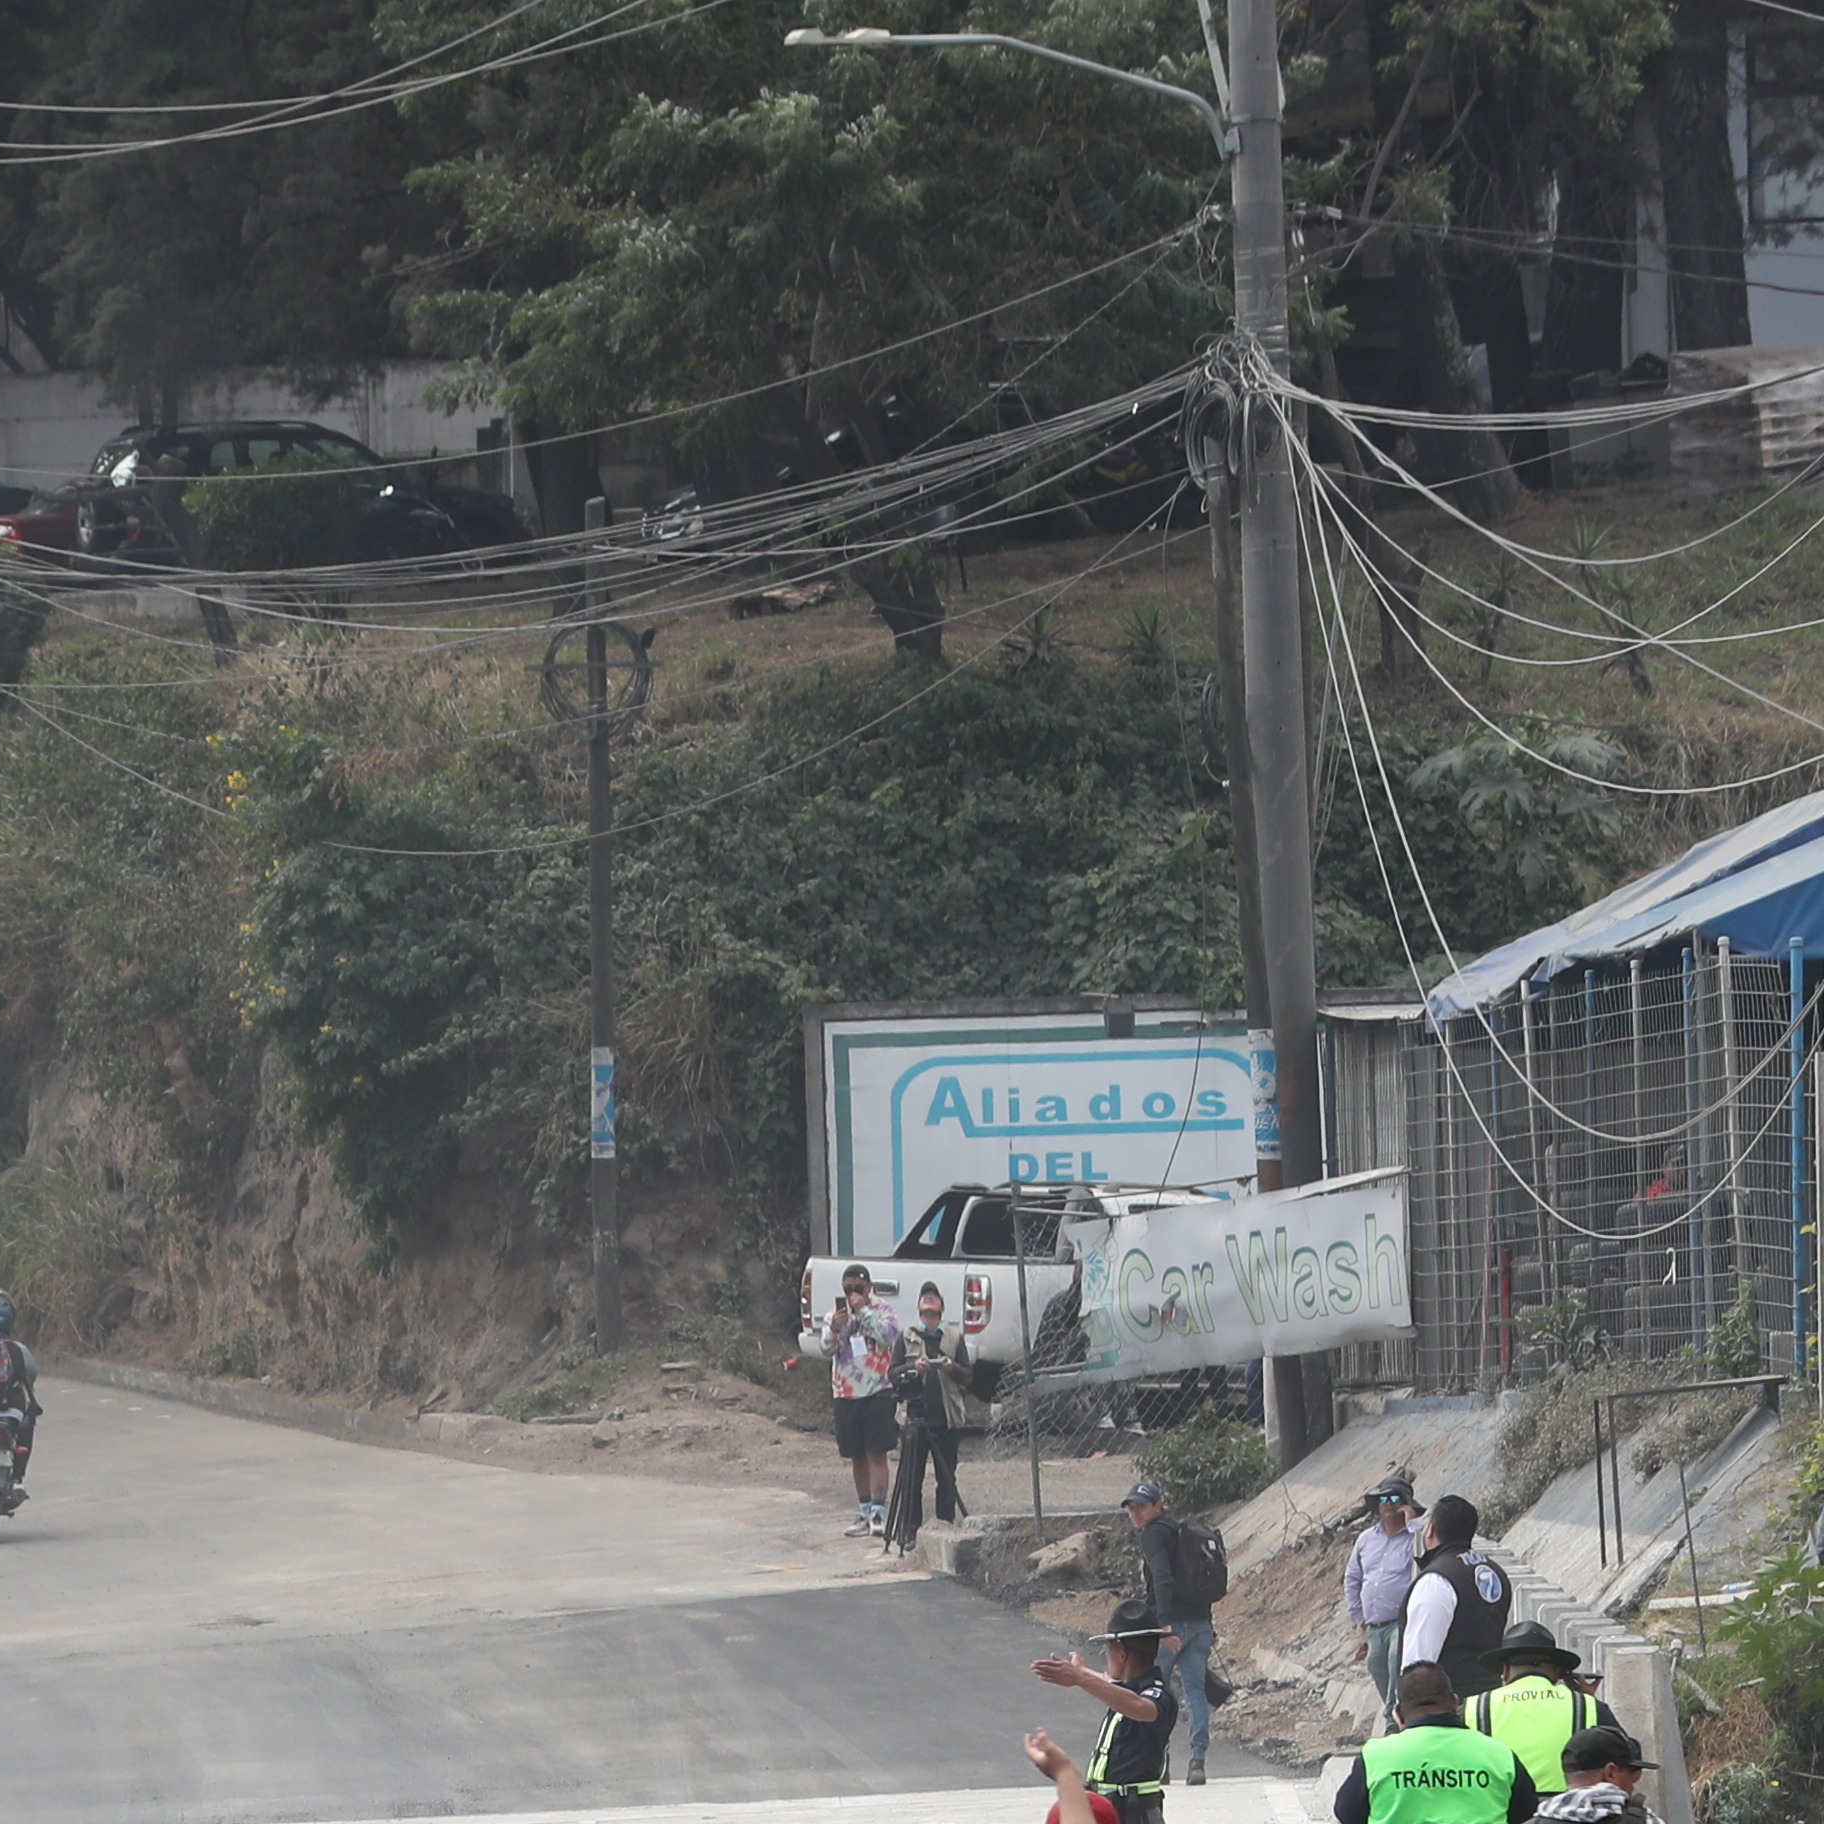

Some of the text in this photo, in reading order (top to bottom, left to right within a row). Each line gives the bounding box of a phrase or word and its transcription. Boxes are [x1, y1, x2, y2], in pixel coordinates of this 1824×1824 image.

[924, 1076, 1228, 1124] Aliados
[1009, 1151, 1109, 1180] DEL
[1119, 1212, 1402, 1342] Car Wash
[1503, 1689, 1565, 1703] PROVIAL
[1393, 1762, 1490, 1789] TRÁNSITO
